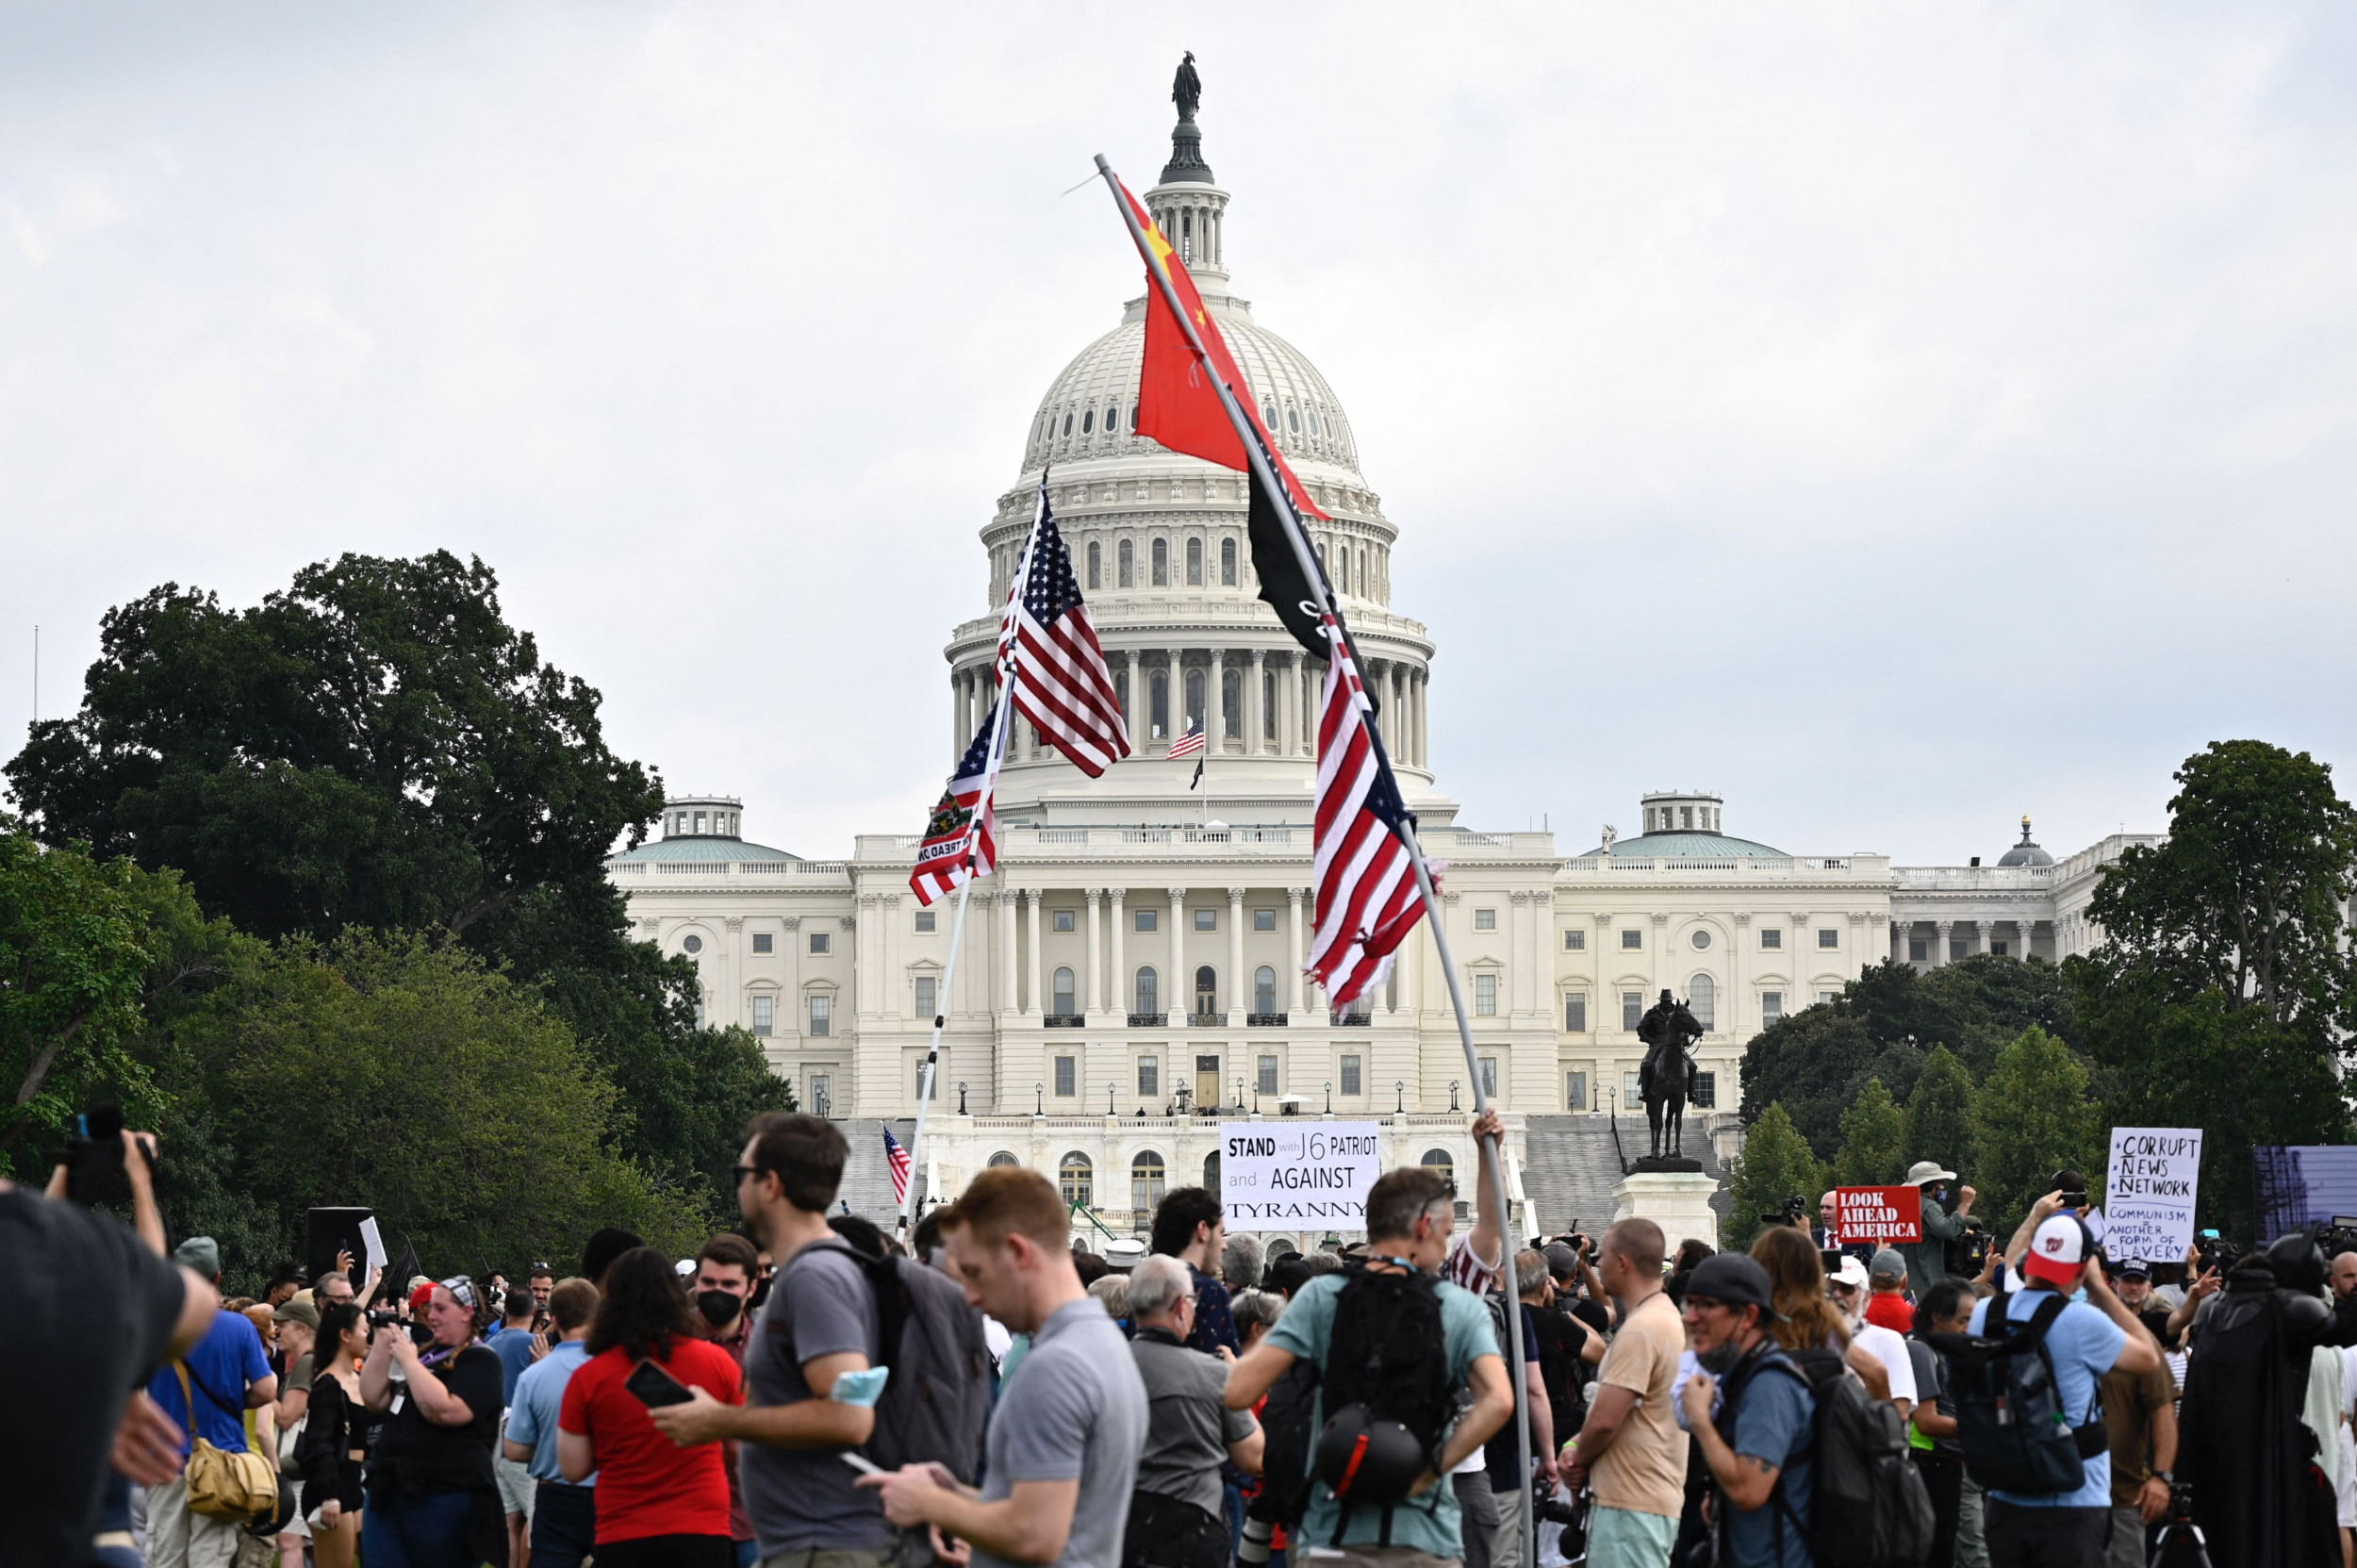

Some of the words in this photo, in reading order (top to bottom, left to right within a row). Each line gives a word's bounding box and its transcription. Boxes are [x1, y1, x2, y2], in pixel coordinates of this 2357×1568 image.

[1228, 1137, 1276, 1157] STAND
[1278, 1142, 1300, 1152] with
[1295, 1132, 1326, 1161] J6
[1330, 1136, 1377, 1156] PATRIOT
[2122, 1135, 2200, 1159] CORRUPT
[2121, 1158, 2168, 1178] NEWS
[1228, 1172, 1257, 1187] and
[1271, 1166, 1355, 1189] AGAINST
[2118, 1178, 2190, 1197] NETWORK
[1839, 1192, 1885, 1207] LOOK
[1227, 1202, 1368, 1218] TYRANNY
[1840, 1207, 1898, 1222] AHEAD
[2109, 1206, 2187, 1223] COMMUNISM
[1840, 1222, 1917, 1238] AMERICA
[2107, 1225, 2163, 1235] ANOTHER
[2119, 1235, 2152, 1246] FORM
[2159, 1235, 2175, 1245] OF
[2108, 1245, 2184, 1260] SLAVERY
